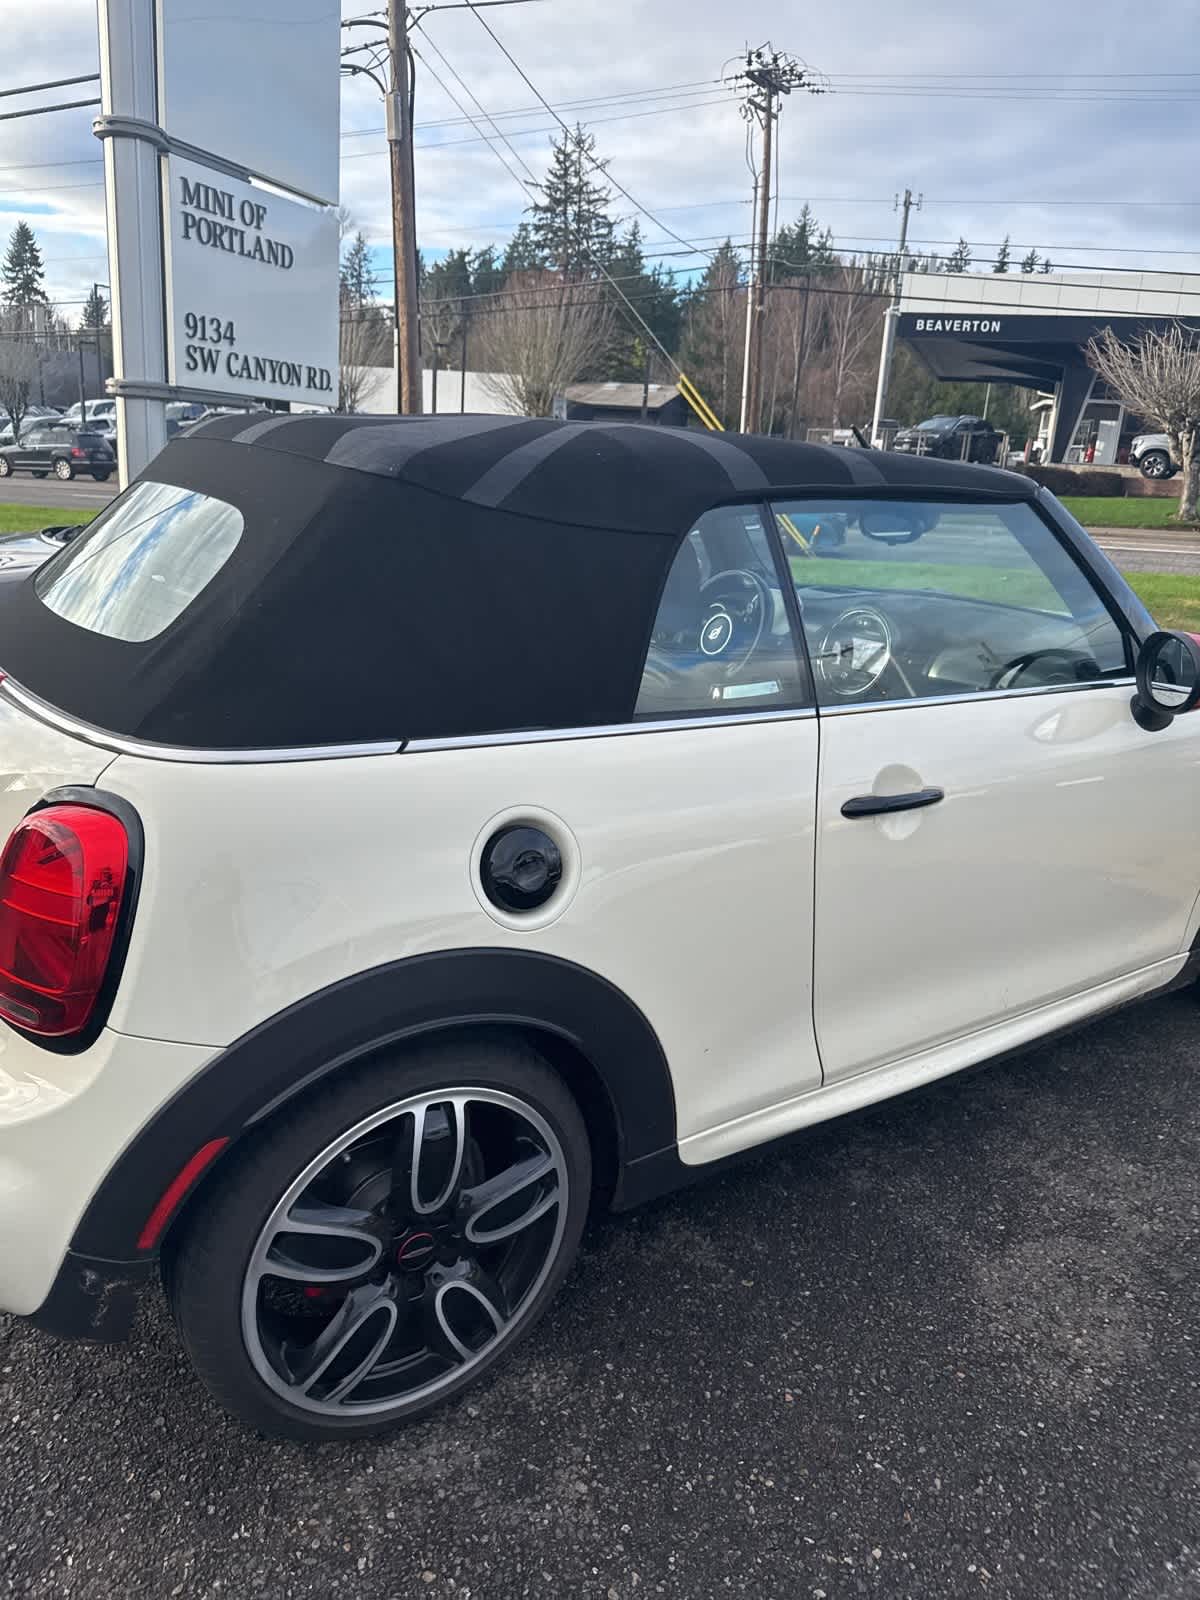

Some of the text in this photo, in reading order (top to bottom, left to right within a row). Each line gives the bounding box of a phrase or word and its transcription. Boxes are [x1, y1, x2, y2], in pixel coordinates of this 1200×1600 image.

[180, 176, 267, 230] MINI OF
[180, 211, 294, 269] PORTLAND
[185, 312, 236, 346] 9134
[916, 319, 1001, 333] BEAVERTON
[185, 345, 333, 392] SW CANYON RD.
